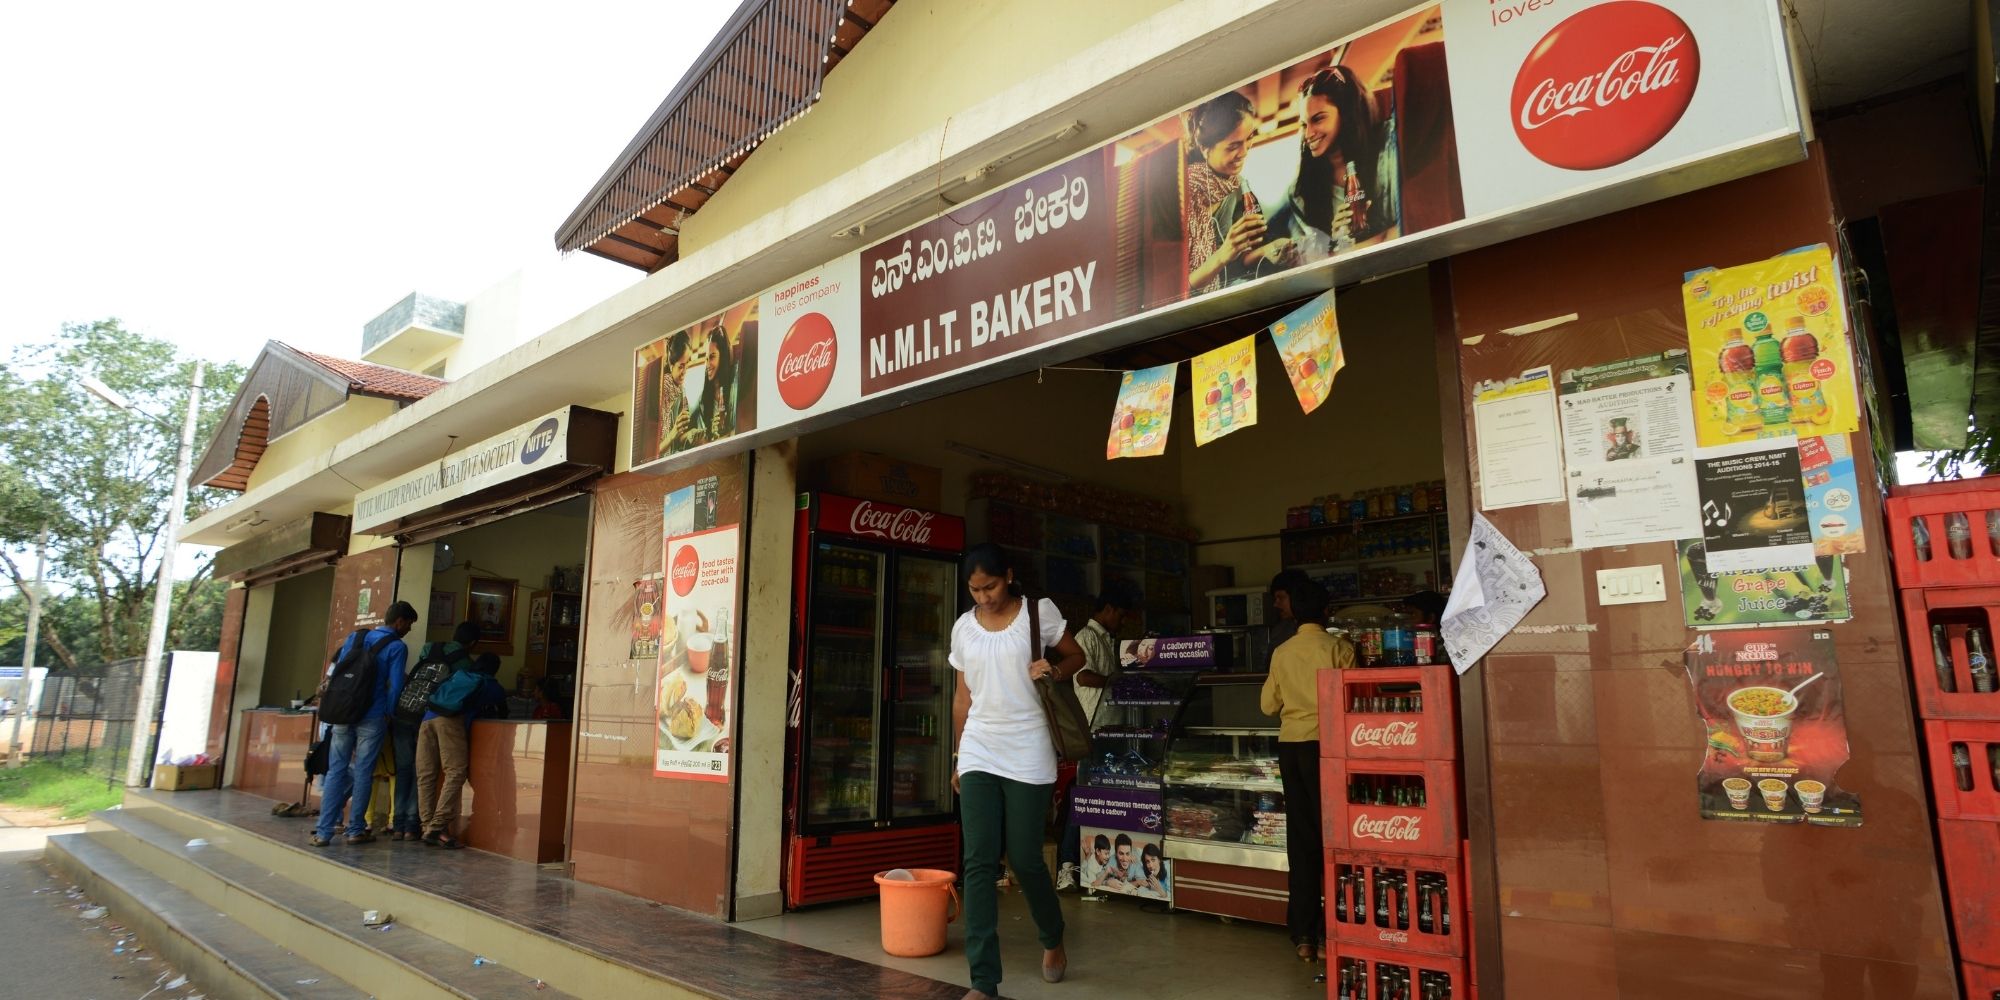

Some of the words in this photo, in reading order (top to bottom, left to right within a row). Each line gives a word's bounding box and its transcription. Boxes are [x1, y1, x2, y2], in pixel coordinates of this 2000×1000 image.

[1520, 33, 1686, 130] Coca-Cola
[775, 276, 820, 302] happiness
[1712, 295, 1734, 308] Try
[1737, 287, 1757, 299] the
[1767, 266, 1817, 300] twist
[775, 301, 796, 316] loves
[799, 281, 841, 306] company
[870, 310, 961, 379] N.M.I.T.
[971, 260, 1097, 348] BAKERY
[1700, 297, 1763, 329] refreshing
[779, 337, 834, 382] Coca-Cola
[1619, 386, 1662, 398] PRODUCTIONS
[1762, 386, 1781, 395] Lipton
[1794, 381, 1815, 390] Lipton
[1732, 391, 1751, 400] Lipton
[1598, 398, 1639, 409] AUDITIONS
[525, 429, 553, 453] NITTE
[1717, 464, 1753, 474] AUDITIONS
[1754, 460, 1780, 469] 2014-15
[1722, 459, 1743, 467] MUSIC
[1745, 455, 1767, 463] CREW,
[356, 498, 373, 520] NITTE
[373, 478, 423, 516] MULTIPURPOSE
[479, 439, 519, 474] SOCIETY
[851, 500, 935, 544] Coca-Cola
[672, 561, 697, 580] Coca-Cola
[702, 560, 716, 568] food
[717, 558, 734, 567] tastes
[702, 568, 719, 577] better
[720, 566, 734, 574] with
[701, 576, 729, 586] coca-cola
[1734, 578, 1786, 594] Grape
[1738, 597, 1786, 612] Juice
[1179, 649, 1210, 658] occasion
[1745, 643, 1769, 652] CUP
[1736, 650, 1779, 661] NOODLES
[1706, 664, 1761, 677] HUNGRY
[1766, 662, 1782, 675] TO
[1788, 661, 1813, 675] WIN
[1351, 721, 1418, 747] Coca-Cola
[1353, 814, 1422, 842] Coca-Cola
[1379, 930, 1408, 943] Coca-Cola
